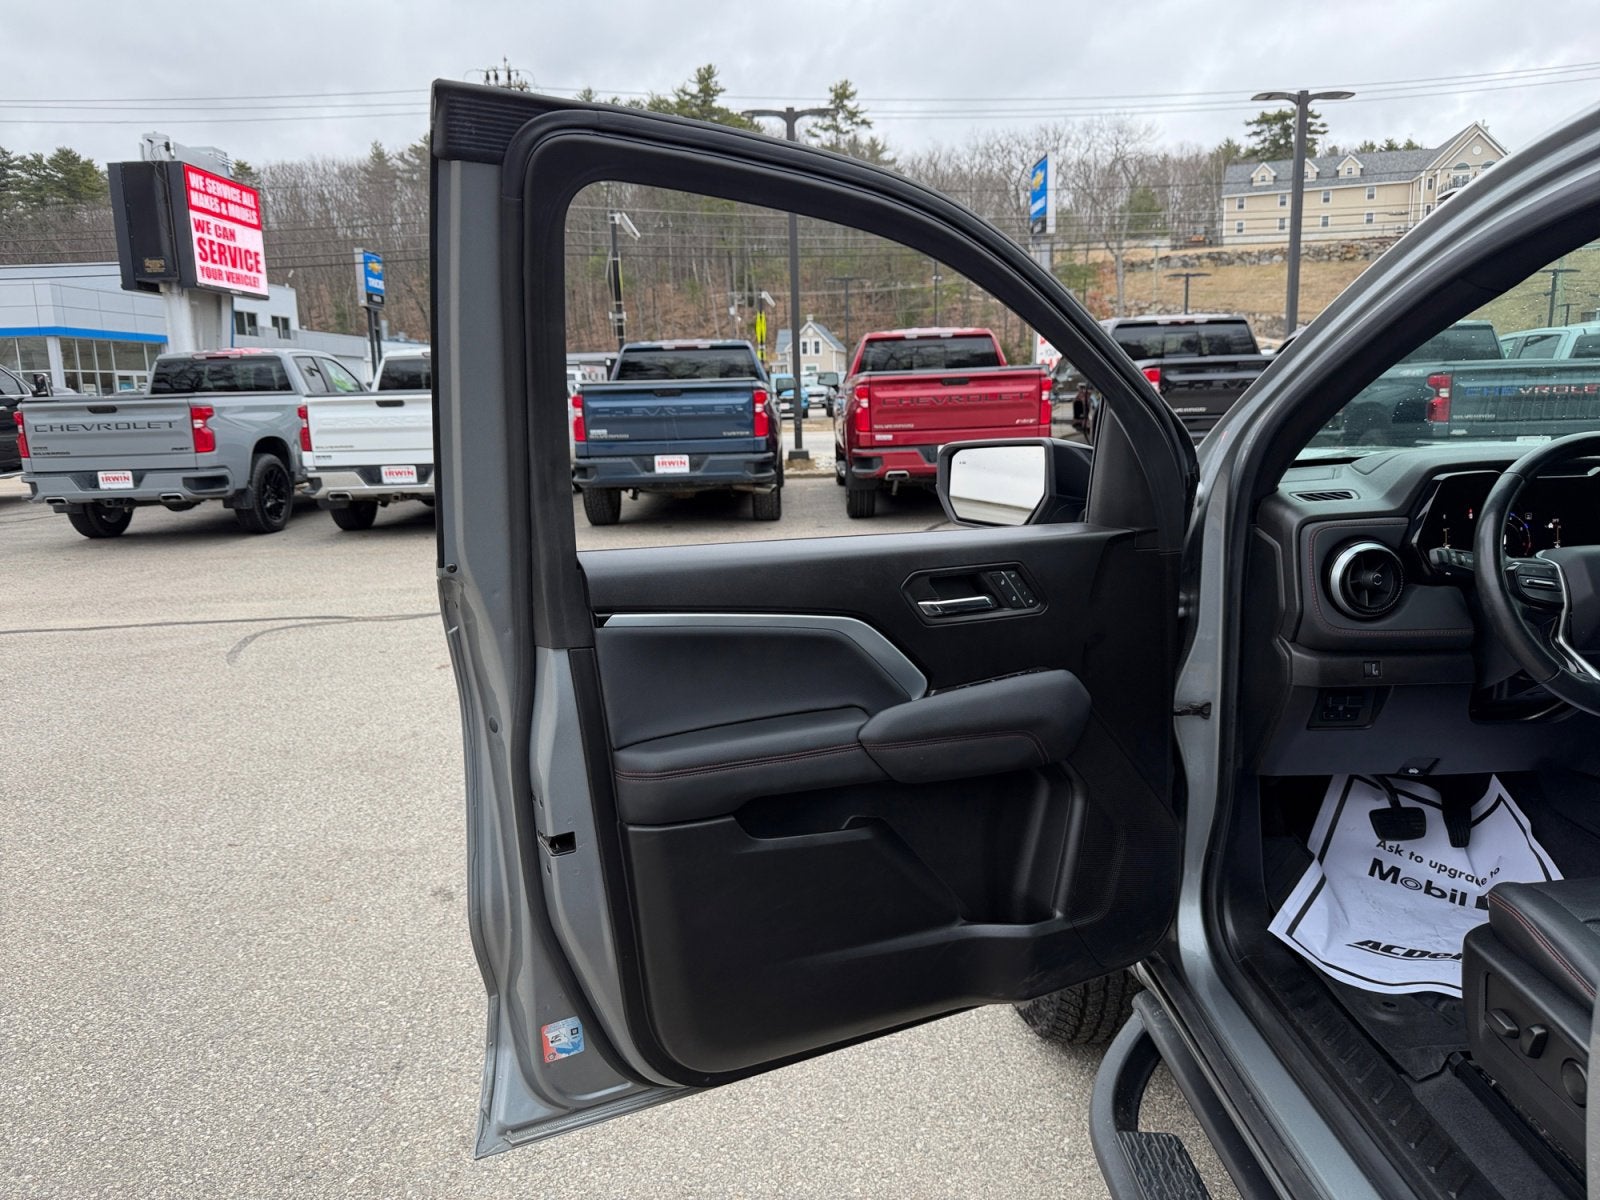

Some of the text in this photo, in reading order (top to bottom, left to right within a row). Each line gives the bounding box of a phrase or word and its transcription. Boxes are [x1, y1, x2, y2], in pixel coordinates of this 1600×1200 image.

[188, 170, 257, 209] WE SERVICE ALL
[189, 189, 221, 214] MAKES
[220, 201, 229, 217] &
[192, 217, 237, 243] WE CAN
[196, 236, 263, 274] SERVICE
[199, 264, 261, 289] YOUR VEHICLE!
[882, 392, 1030, 408] CHEVROLET
[34, 421, 178, 433] CHEVROLET
[657, 459, 687, 468] IRWIN
[101, 475, 130, 483] IRWIN
[1375, 840, 1404, 857] Ask
[1408, 851, 1424, 864] to
[1489, 867, 1500, 879] to
[1367, 857, 1468, 907] Mobil
